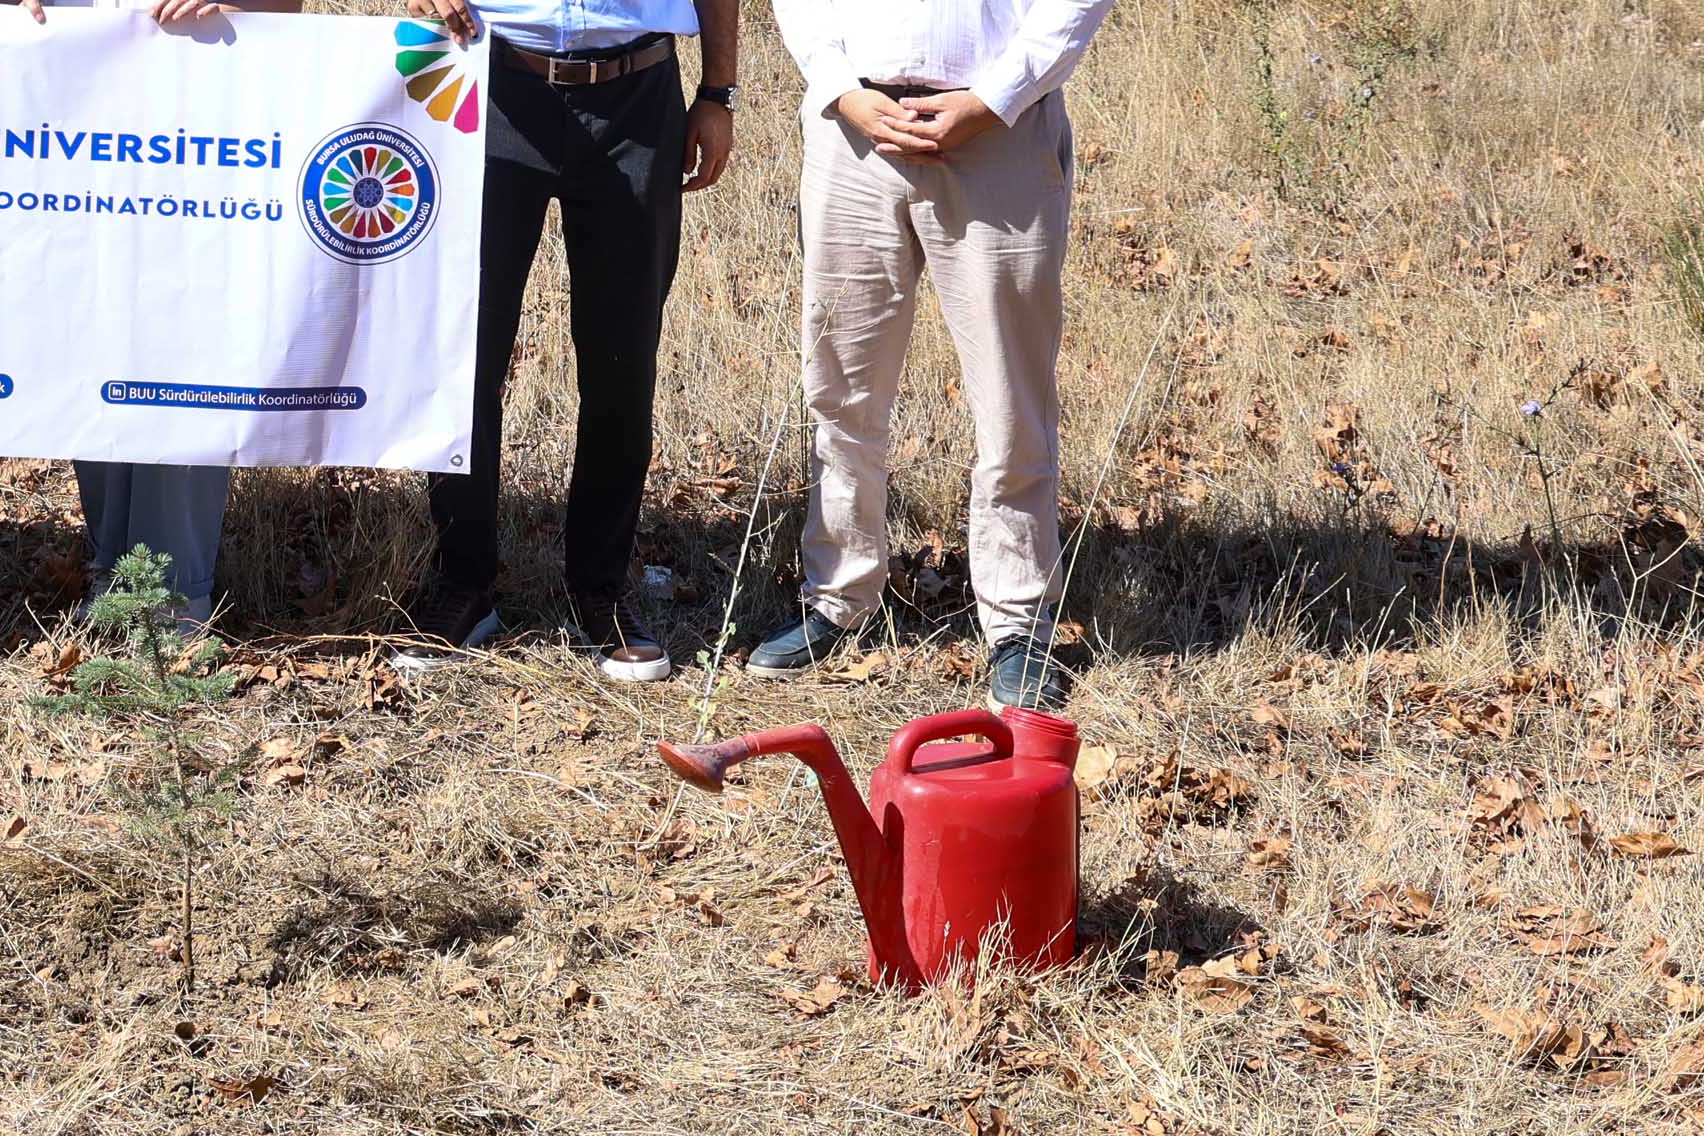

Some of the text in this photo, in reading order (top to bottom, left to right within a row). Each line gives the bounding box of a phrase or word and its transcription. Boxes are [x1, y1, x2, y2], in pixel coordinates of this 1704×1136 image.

[316, 130, 426, 169] BURSA ULUDAĞ ÜNİVERSİTESİ
[129, 387, 358, 408] BUU Sürdürülebilirlik Koordinatörlüğü
